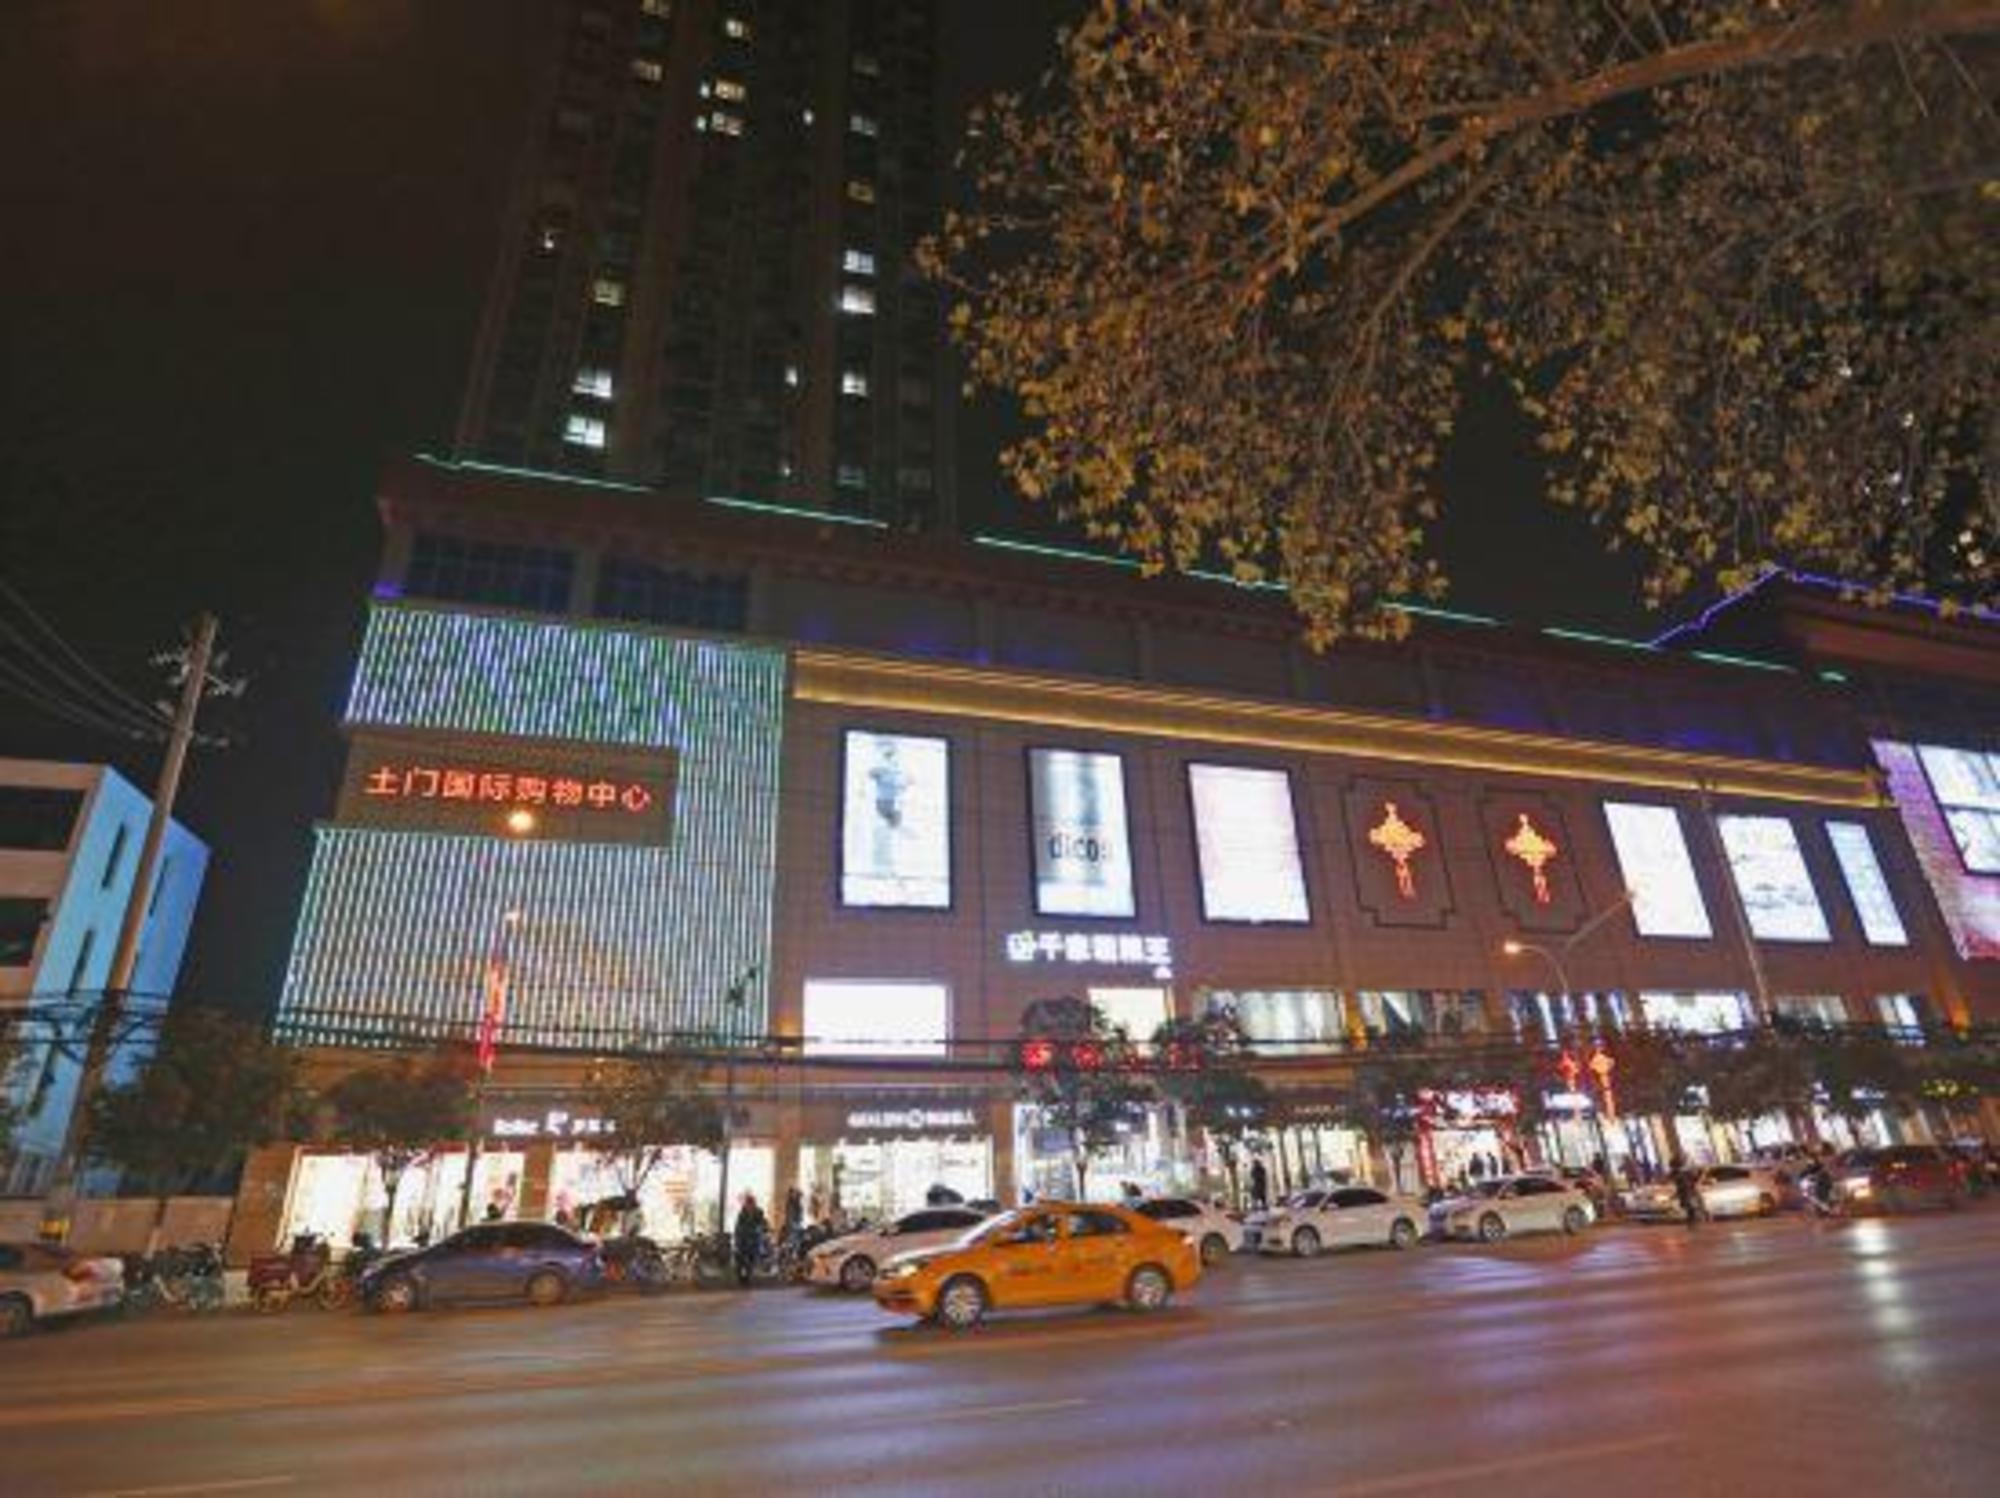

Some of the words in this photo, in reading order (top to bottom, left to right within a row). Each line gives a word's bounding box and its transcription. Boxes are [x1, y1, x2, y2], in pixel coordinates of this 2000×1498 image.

[366, 766, 651, 811] 土门国际购物中心
